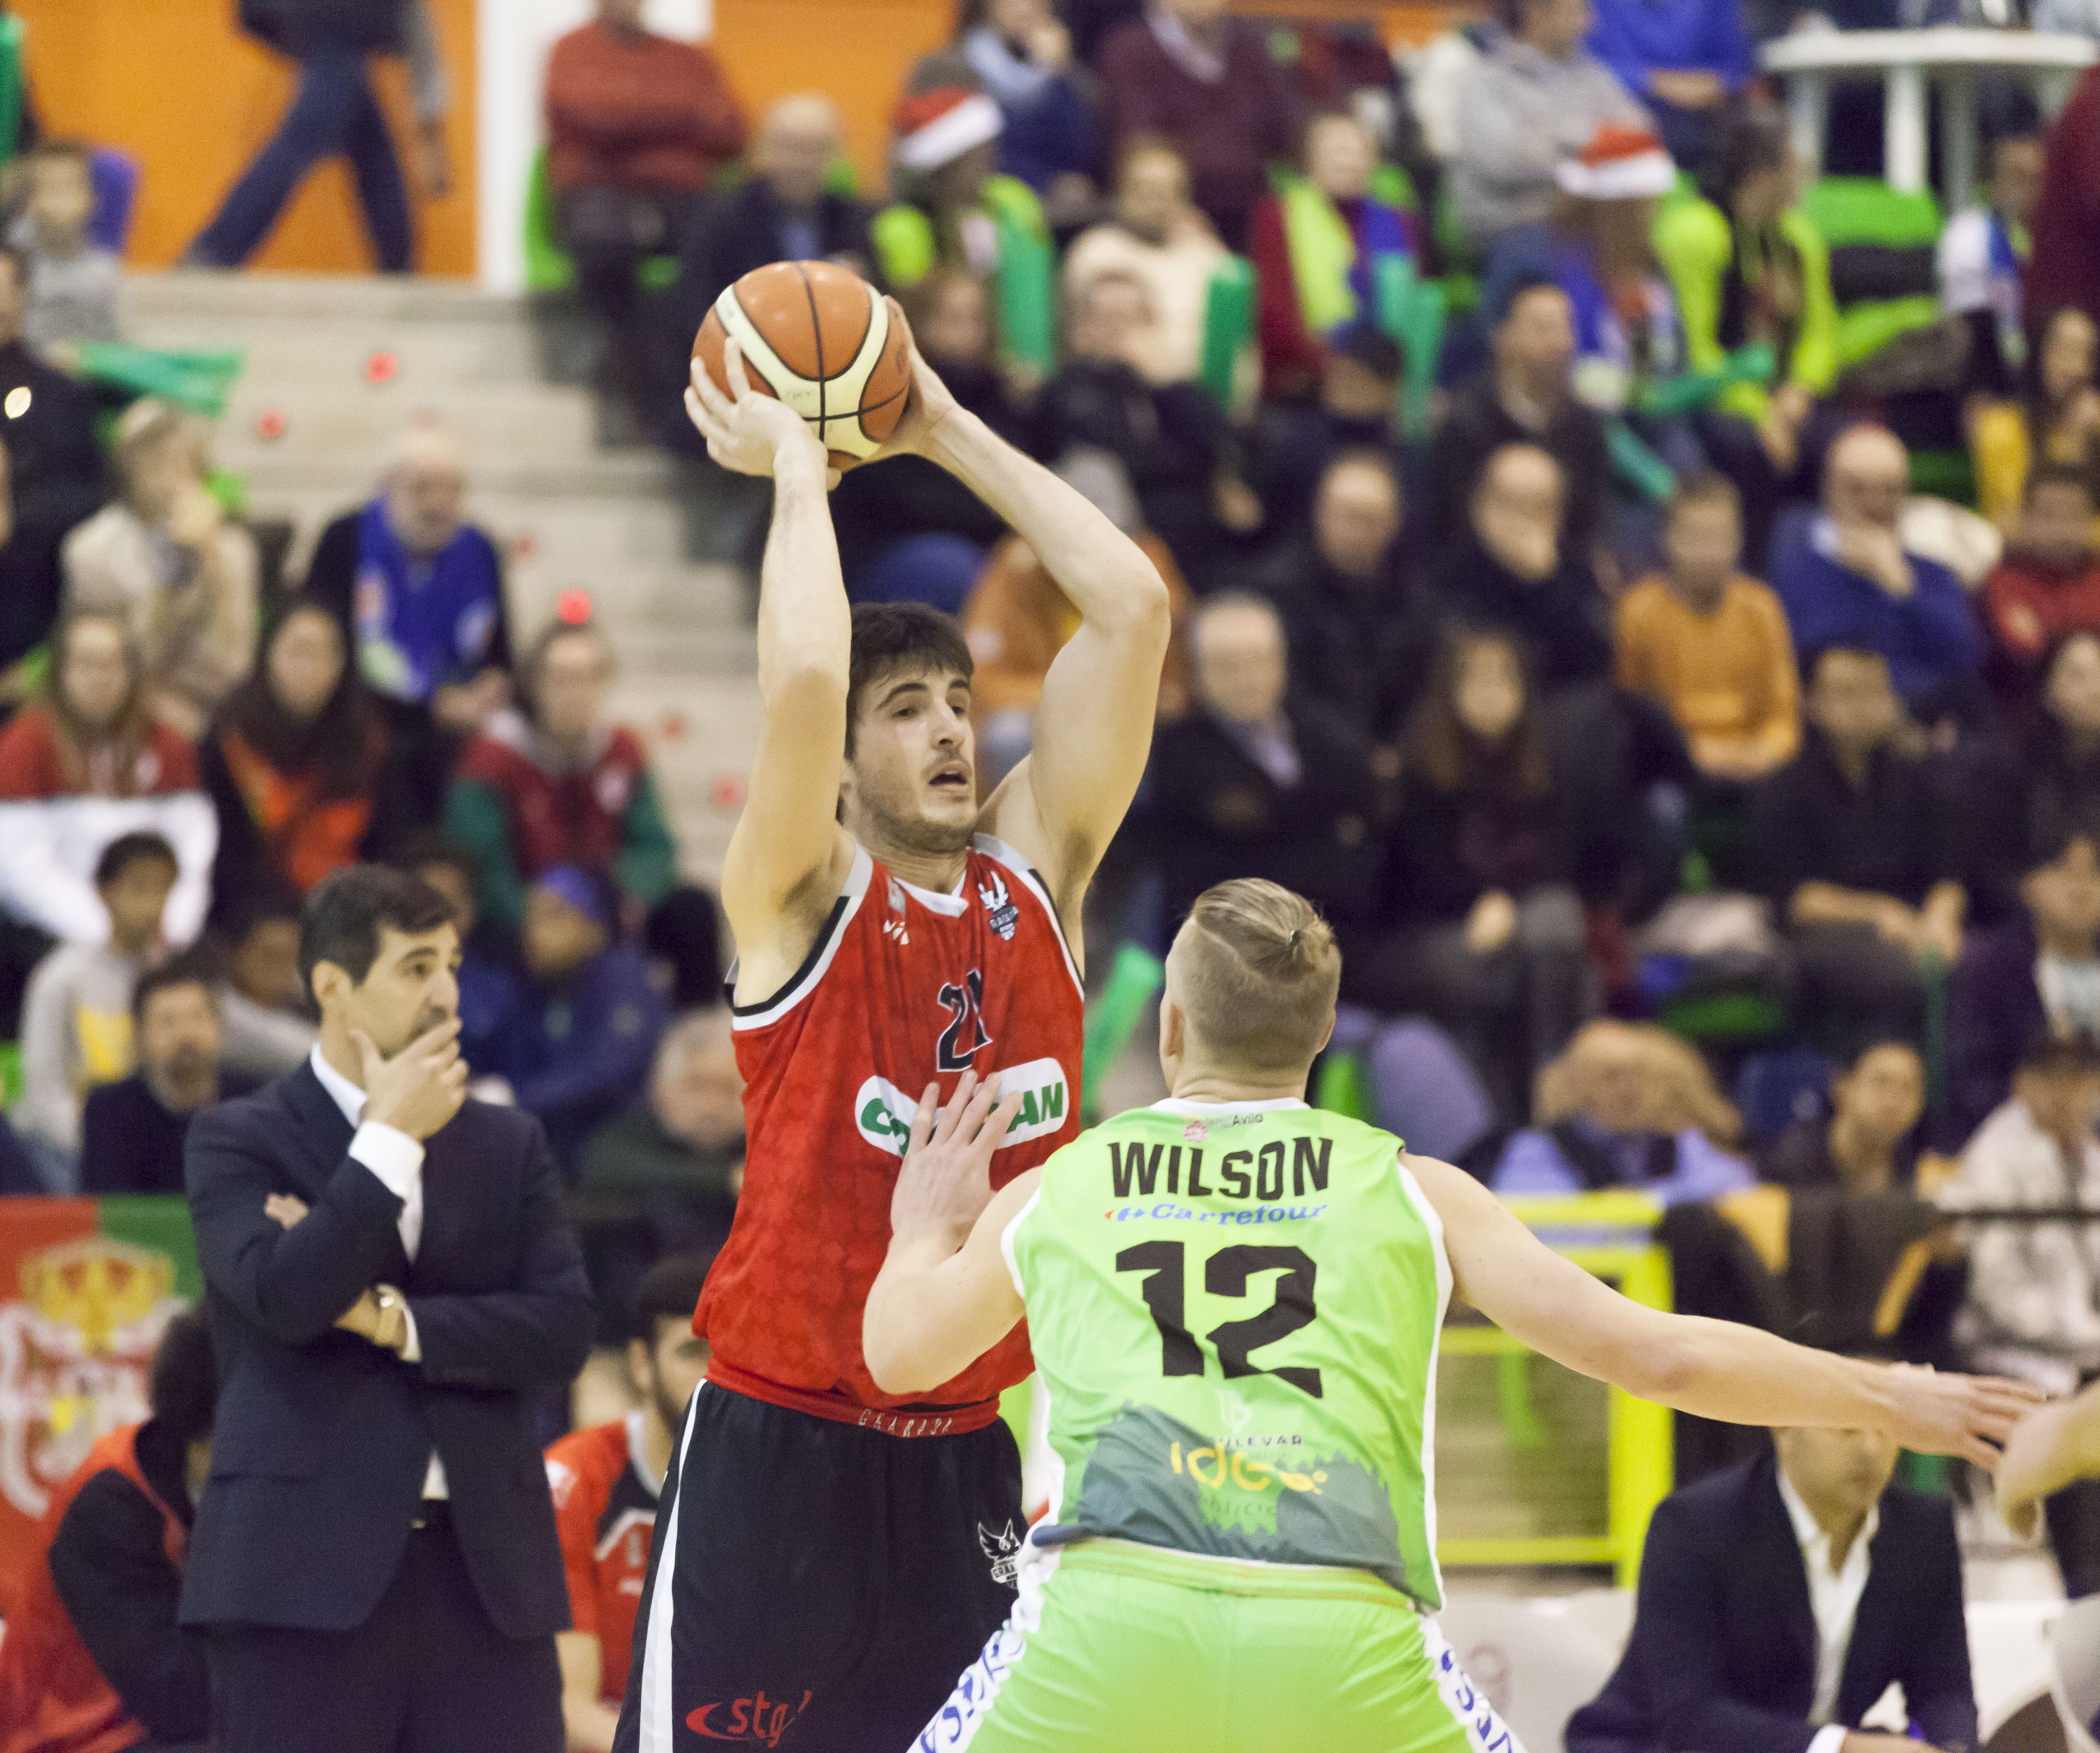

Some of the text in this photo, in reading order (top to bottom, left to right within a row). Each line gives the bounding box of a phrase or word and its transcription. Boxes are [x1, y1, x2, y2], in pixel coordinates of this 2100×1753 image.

[1107, 1136, 1334, 1201] WILSON
[1151, 1203, 1327, 1225] Carrefour
[1116, 1240, 1323, 1399] 12
